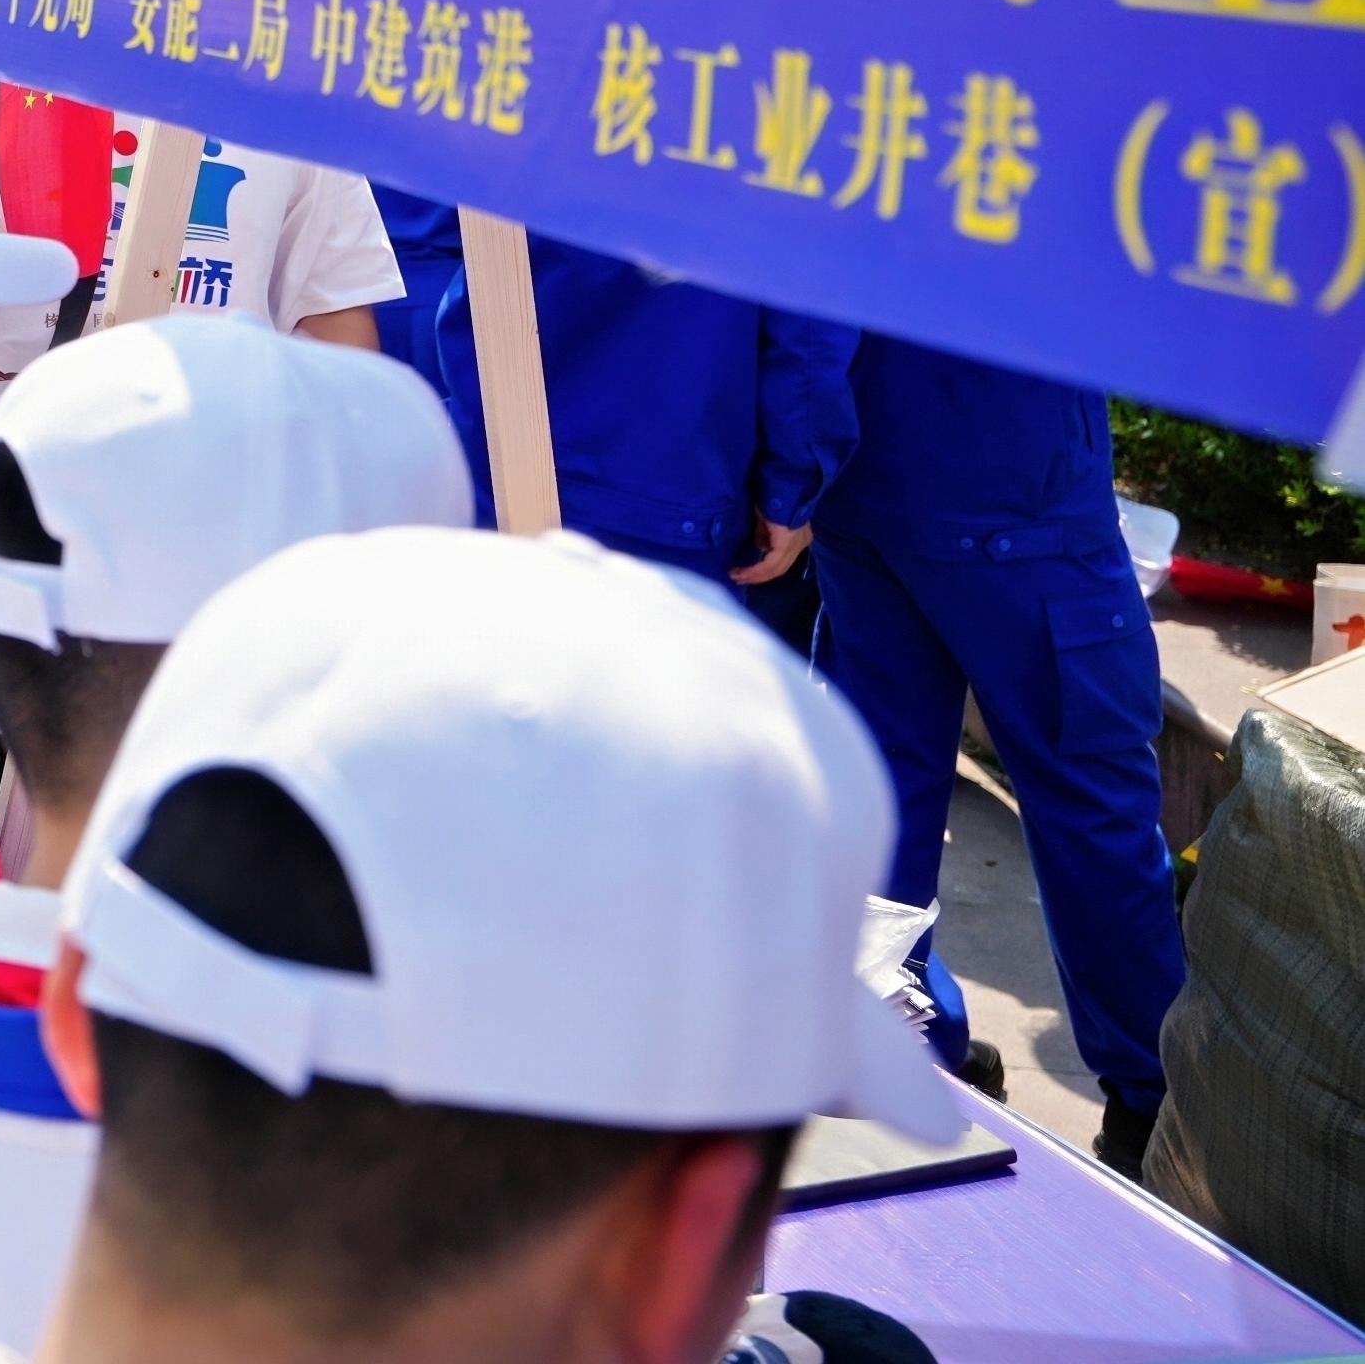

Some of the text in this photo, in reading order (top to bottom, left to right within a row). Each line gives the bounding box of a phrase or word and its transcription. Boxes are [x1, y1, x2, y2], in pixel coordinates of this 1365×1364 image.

[589, 22, 1040, 244] 核工业井巷
